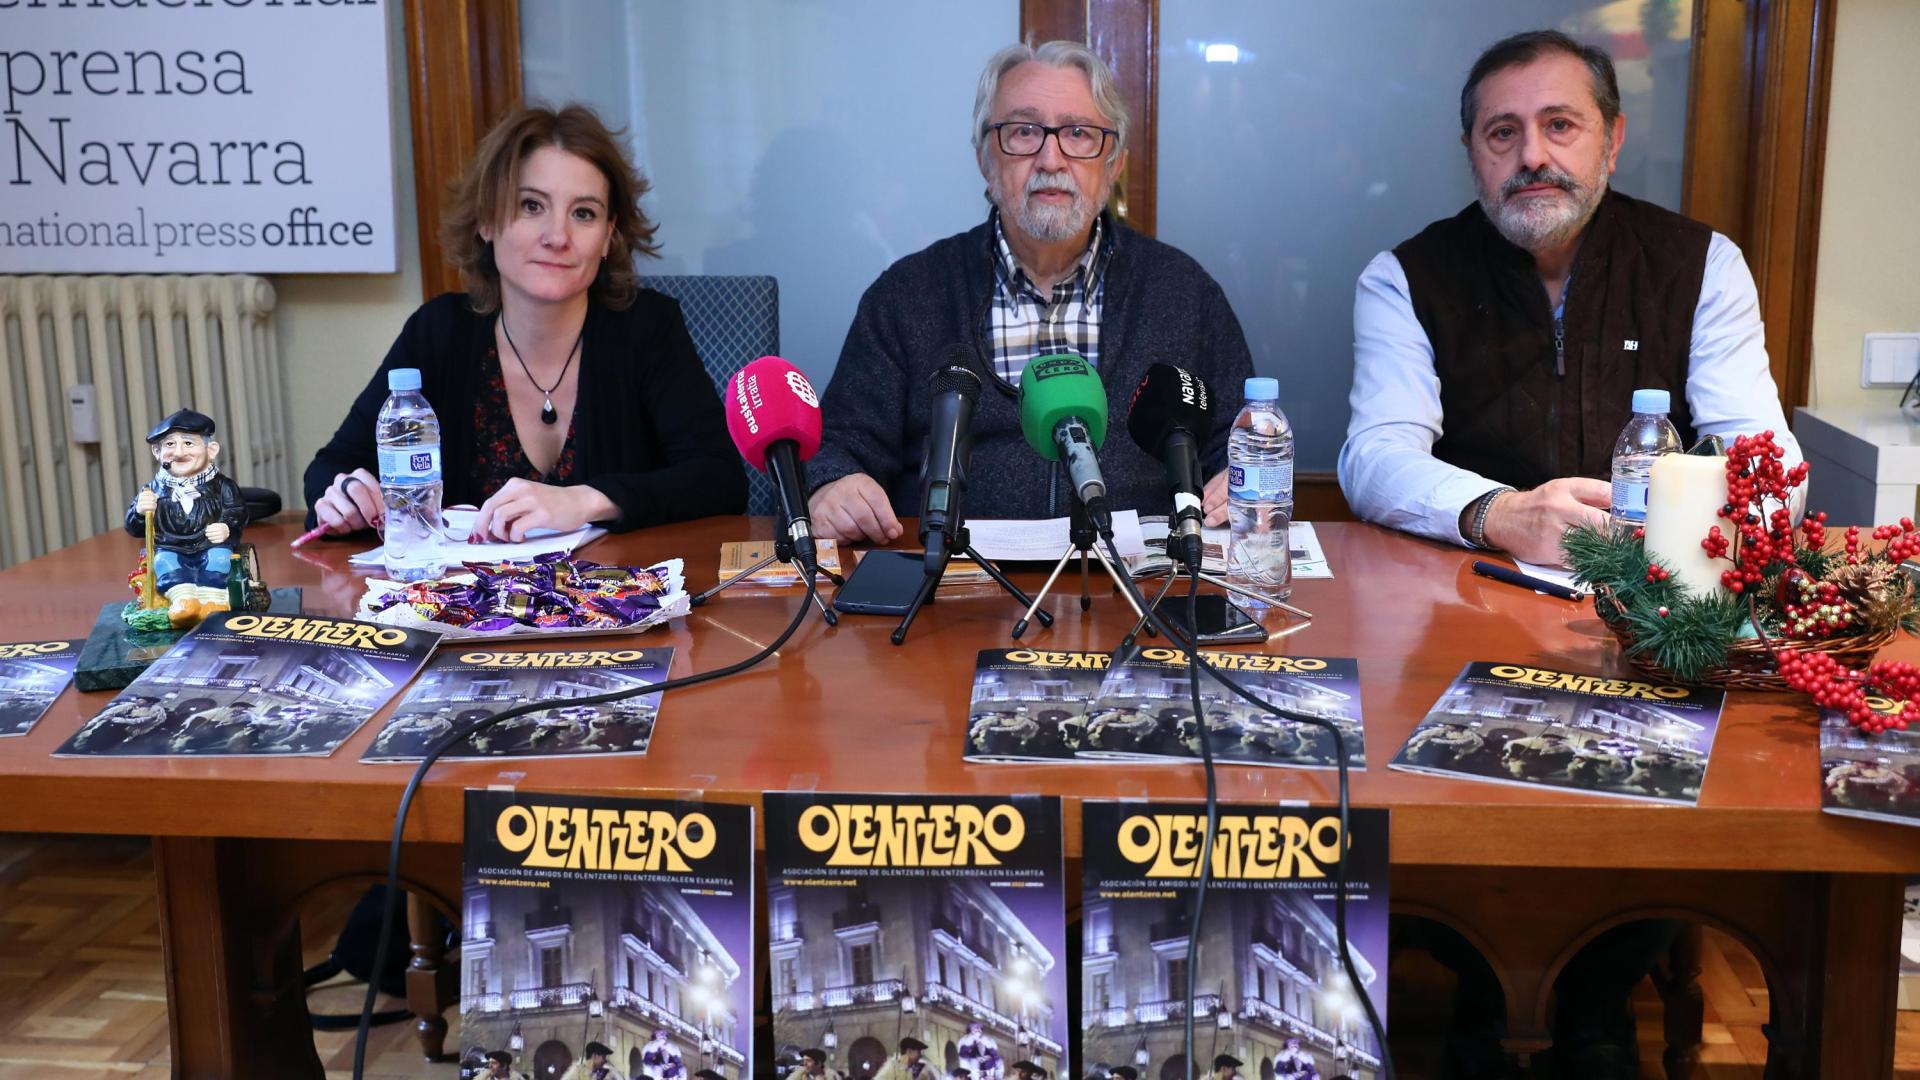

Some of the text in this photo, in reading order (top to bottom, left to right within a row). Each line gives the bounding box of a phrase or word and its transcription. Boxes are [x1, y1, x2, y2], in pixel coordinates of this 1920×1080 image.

[0, 50, 252, 115] prensa
[5, 118, 312, 186] Navarra
[746, 374, 763, 410] irratia
[225, 615, 408, 650] OLENTZERO
[460, 650, 643, 667] OLENTZERO
[1141, 648, 1327, 673] OLNTZERO
[1490, 665, 1690, 700] OLENTZERO
[496, 805, 717, 872] OLENTZERO
[798, 804, 1026, 866] OLENTZERO
[1117, 814, 1351, 879] OLENTZERO
[478, 878, 550, 888] www.olentzero.net
[534, 869, 561, 878] AMIGOS
[563, 871, 572, 879] DE
[574, 872, 617, 880] OLENTZERO
[829, 868, 838, 876] DE
[870, 868, 879, 876] DE
[1207, 881, 1247, 889] LENTZERO
